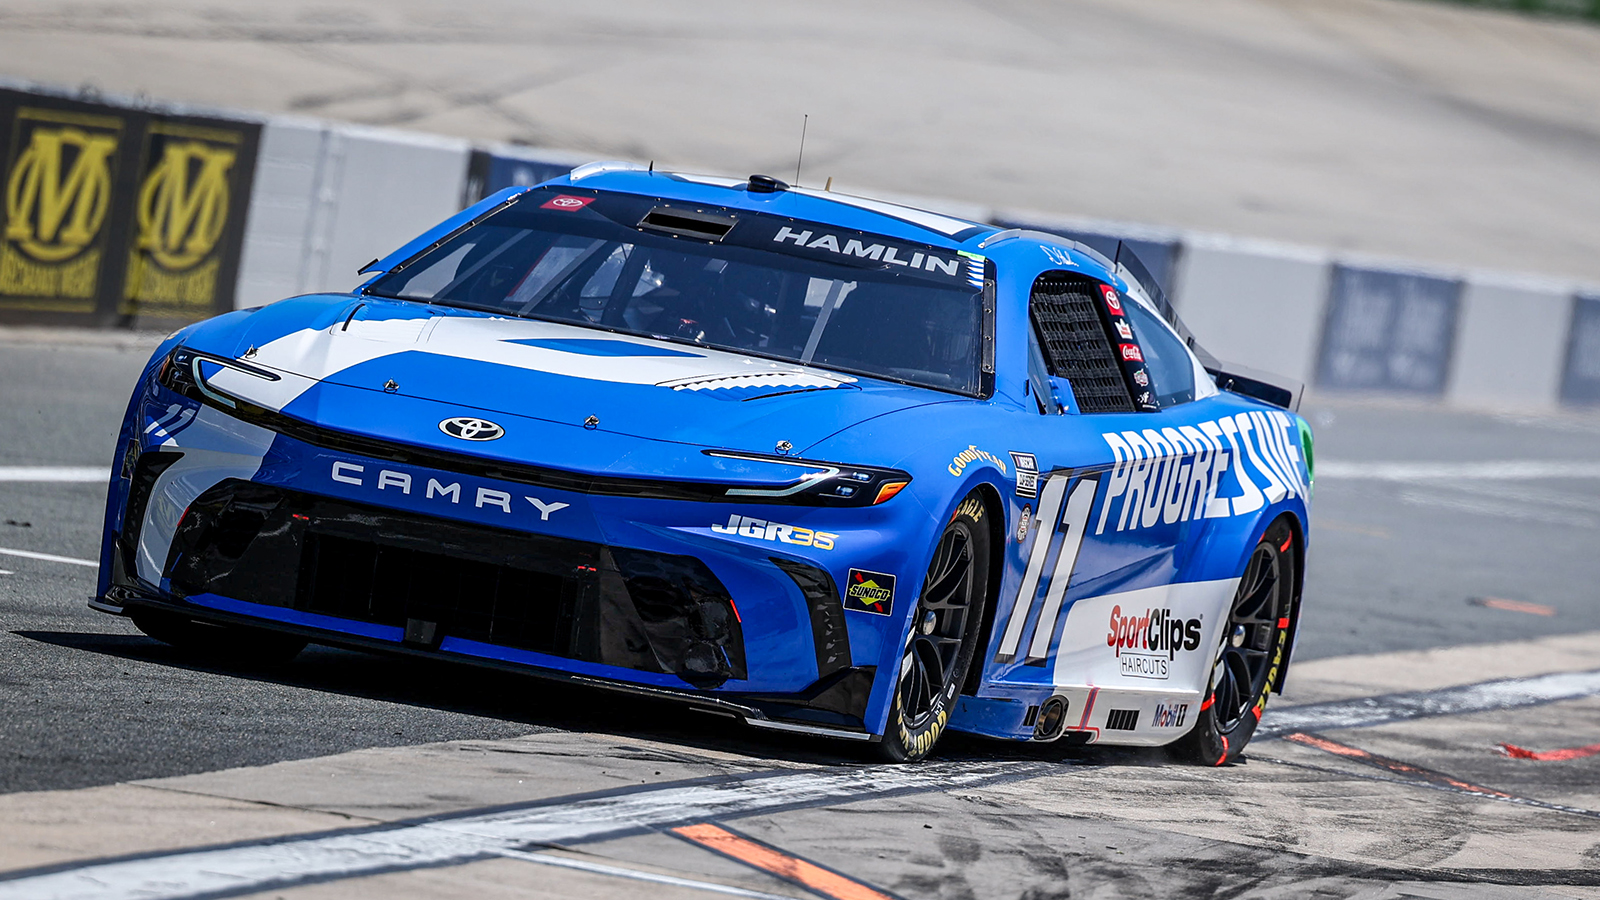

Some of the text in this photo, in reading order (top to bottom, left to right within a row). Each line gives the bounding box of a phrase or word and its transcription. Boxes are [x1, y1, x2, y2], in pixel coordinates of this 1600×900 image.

[773, 226, 960, 277] HAMLIN
[143, 403, 197, 438] 11
[947, 444, 1007, 477] GOODYEAR
[1095, 410, 1306, 535] PROGRESSIVE
[331, 460, 569, 521] CAMRY
[999, 474, 1098, 658] 11
[850, 584, 891, 602] SUNOCO
[1121, 657, 1168, 675] HAIRCUTS
[1151, 704, 1178, 727] Mobil
